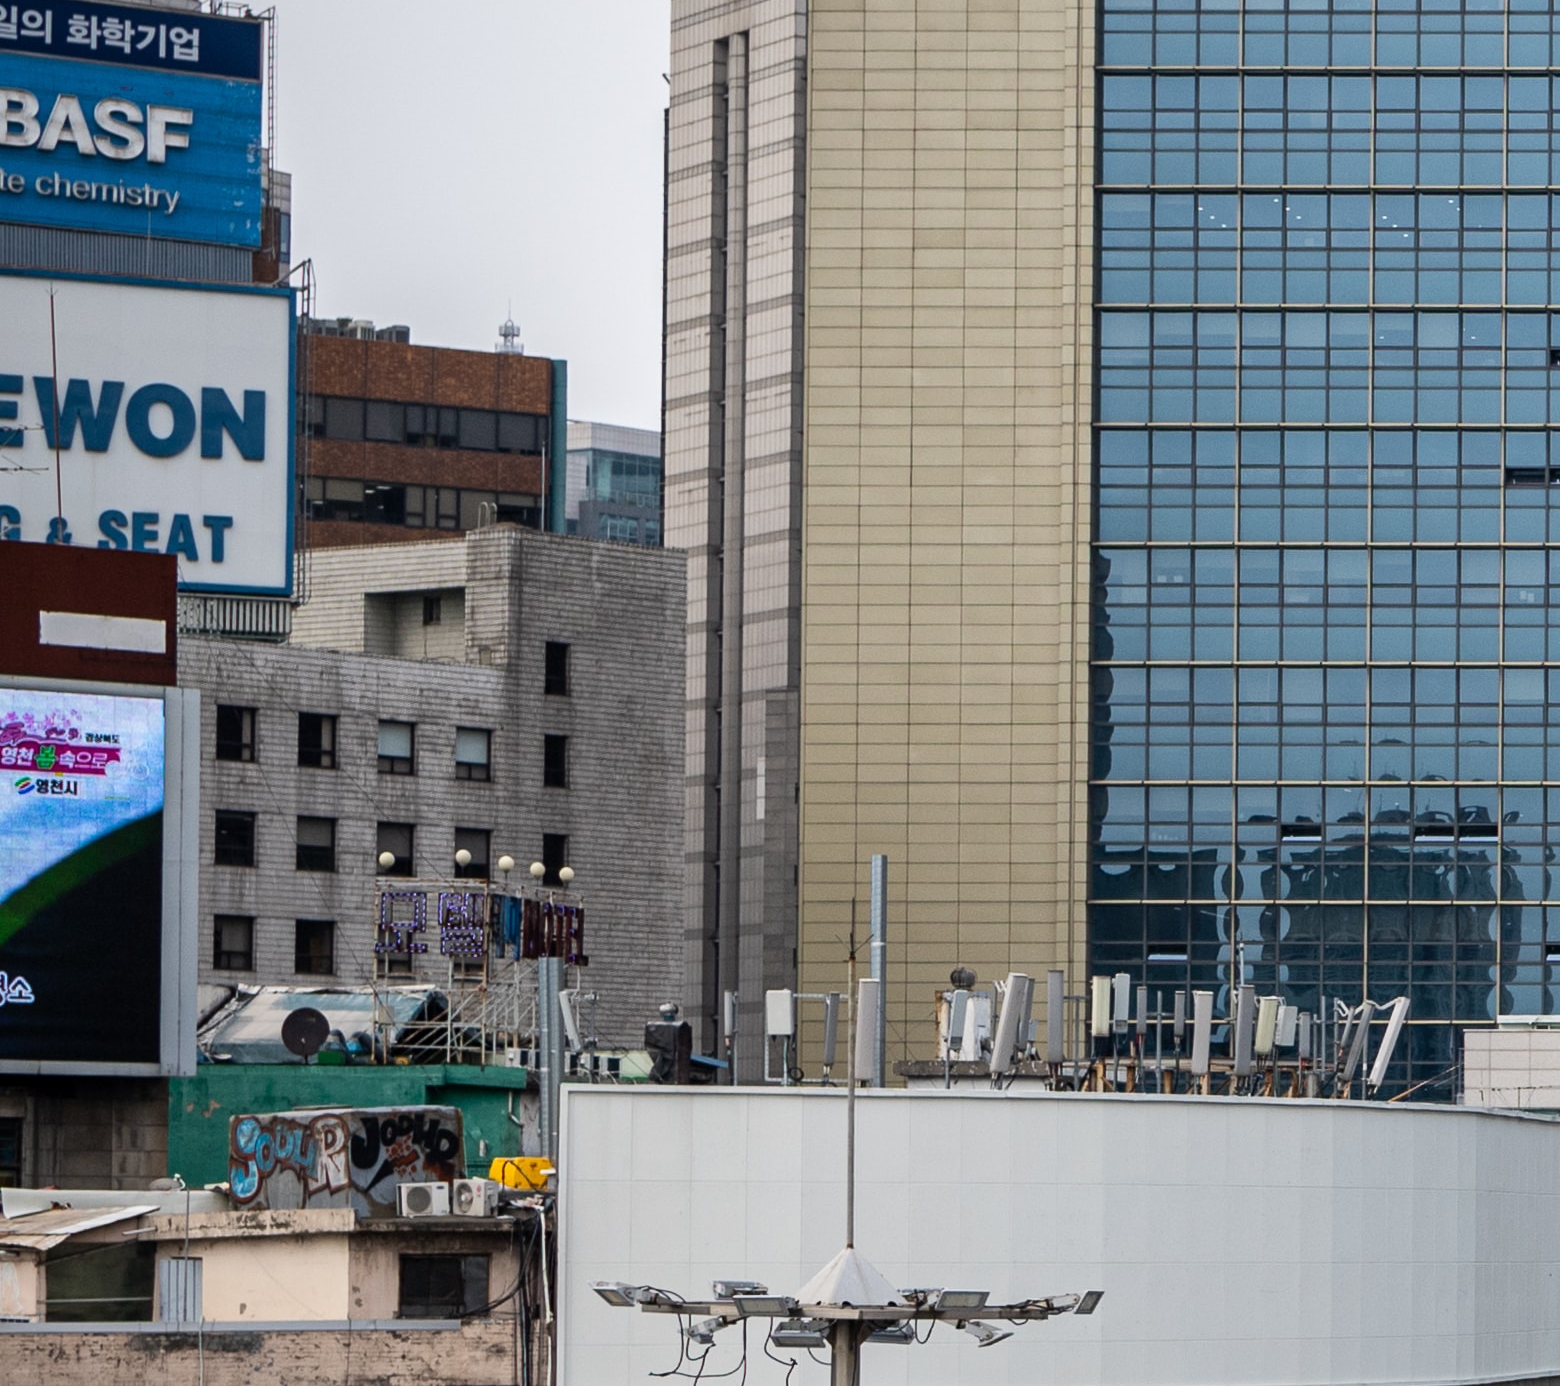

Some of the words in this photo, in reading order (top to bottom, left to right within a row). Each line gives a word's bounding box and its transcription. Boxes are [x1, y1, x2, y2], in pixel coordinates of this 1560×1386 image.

[66, 13, 200, 62] 화학기업
[0, 86, 194, 164] BASF
[35, 170, 181, 215] chemistry
[97, 508, 234, 563] SEAT
[1, 745, 35, 766] 영천
[59, 750, 108, 770] 속으로
[36, 777, 79, 796] 영천시
